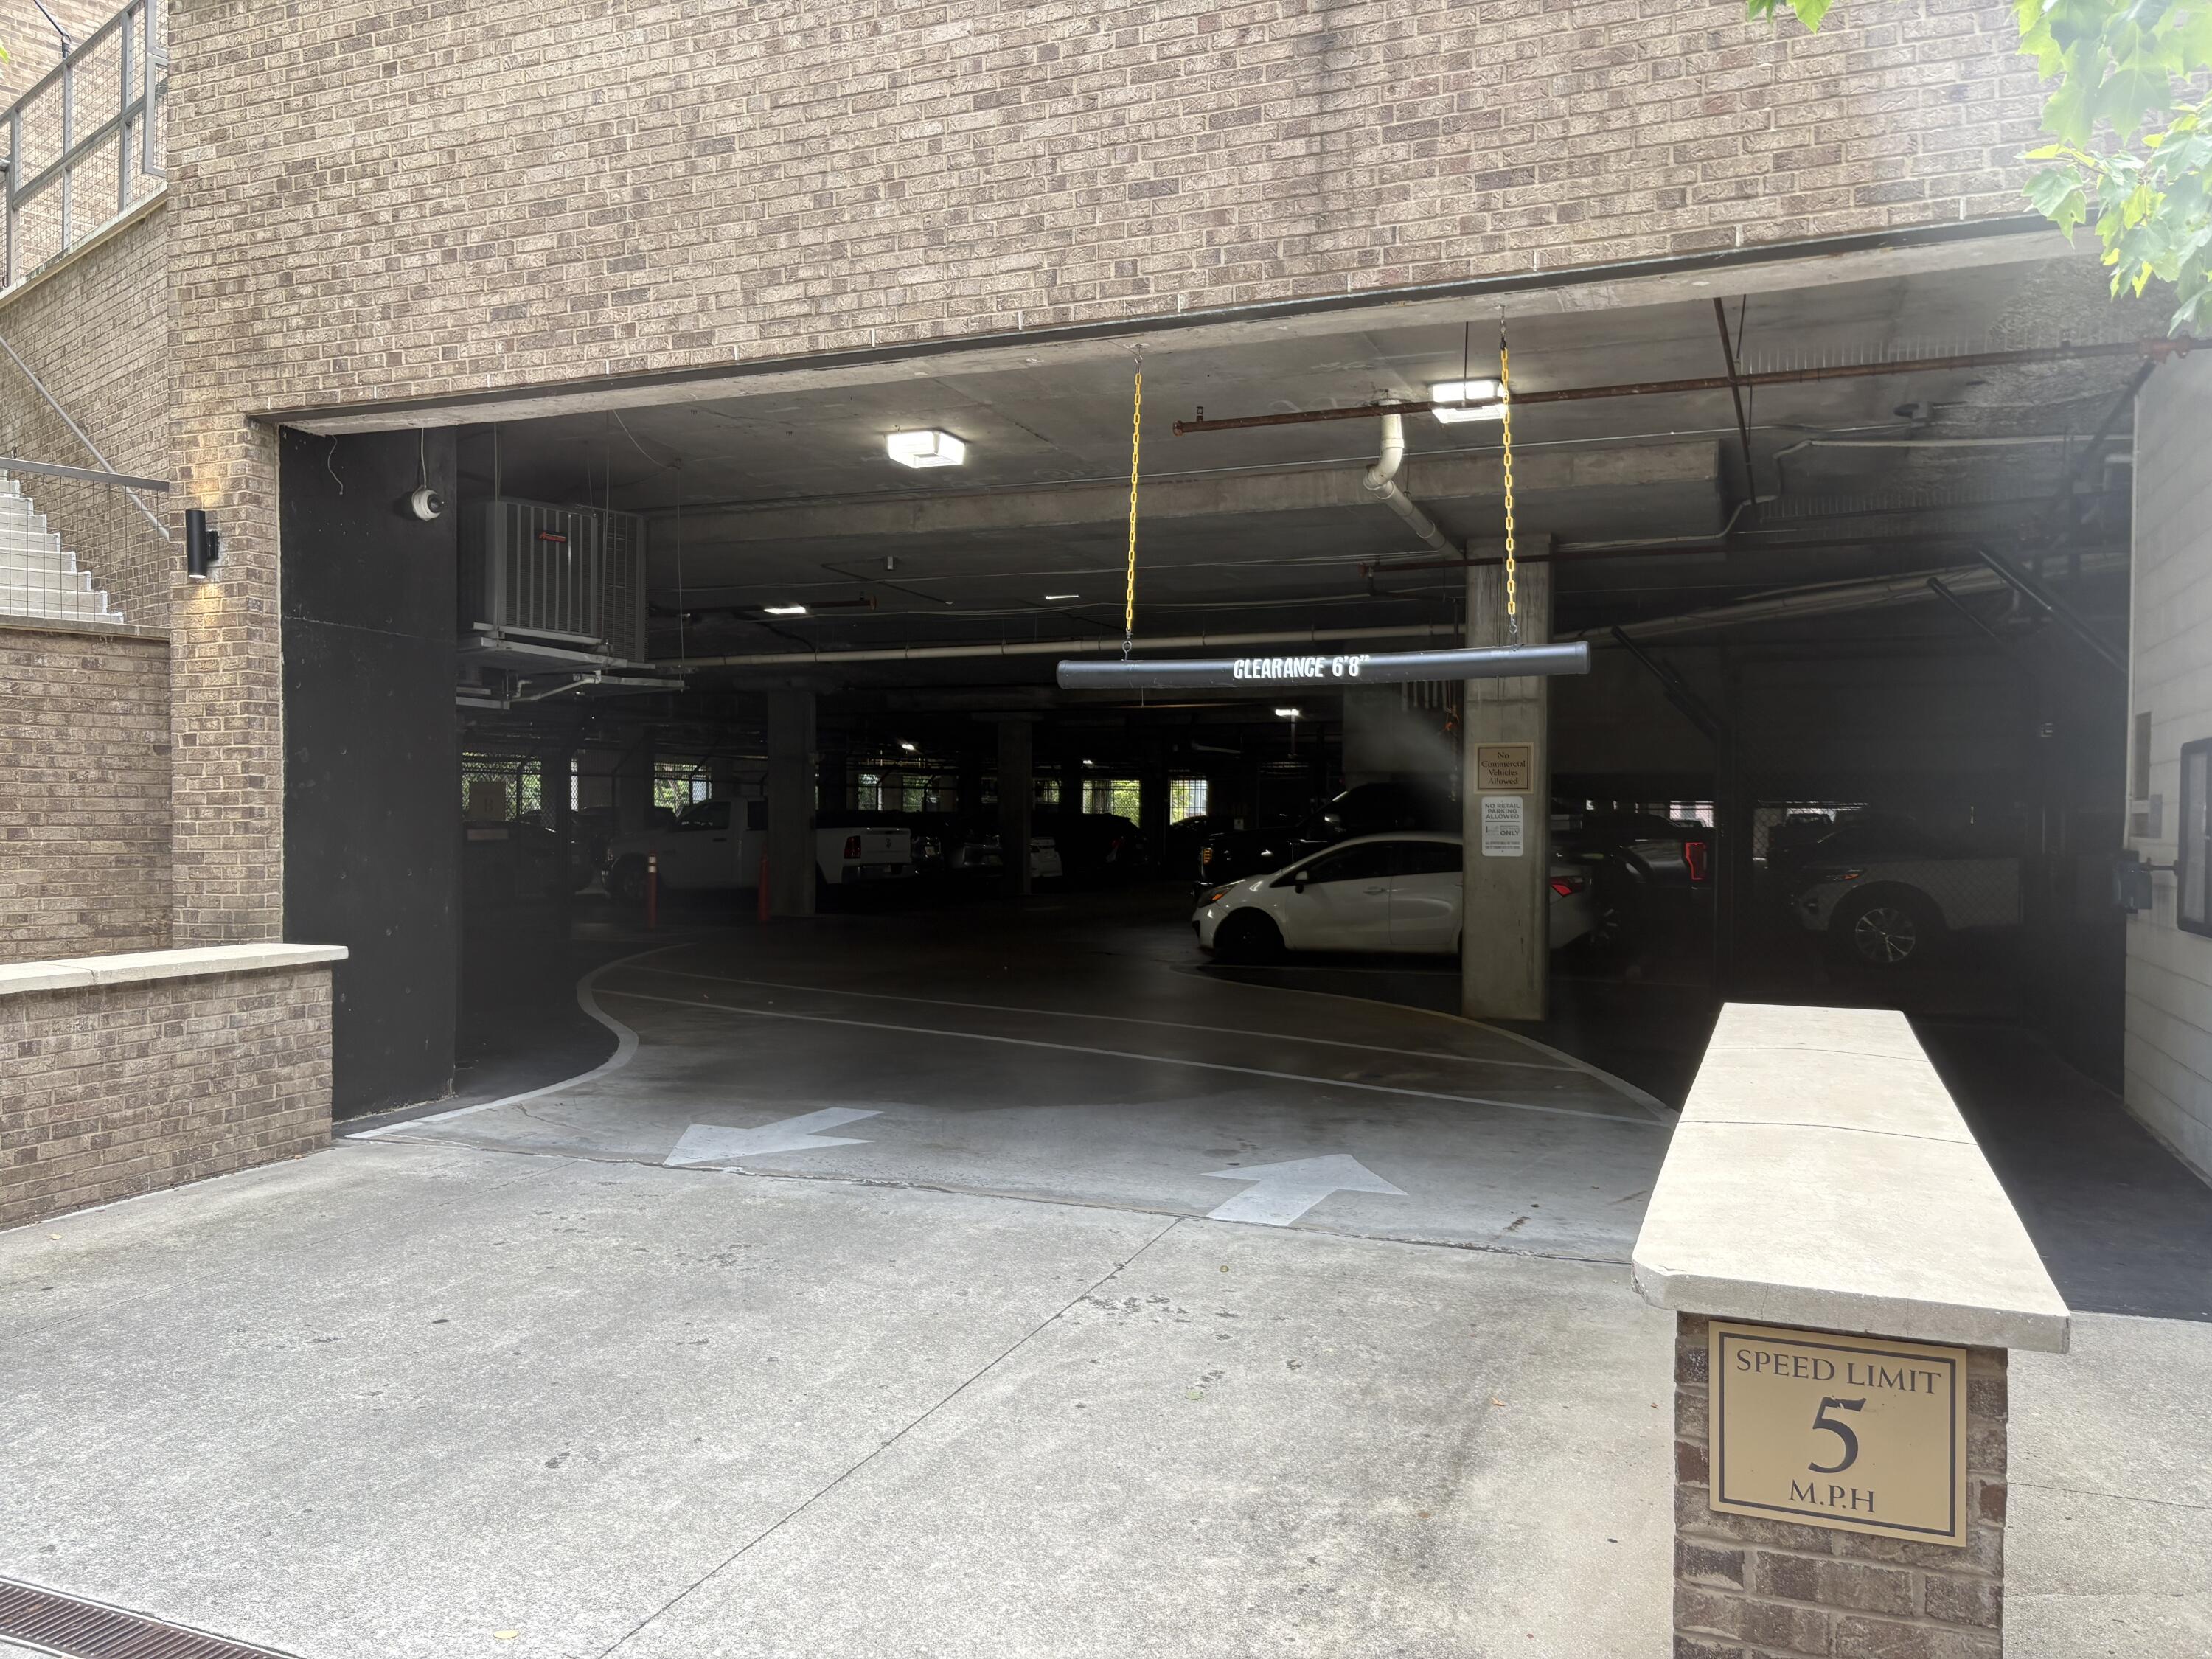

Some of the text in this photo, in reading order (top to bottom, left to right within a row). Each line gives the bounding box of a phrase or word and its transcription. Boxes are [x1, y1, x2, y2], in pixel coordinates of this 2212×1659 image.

[1233, 657, 1326, 680] CLEARANCE
[1481, 760, 1526, 768] Commercial
[1488, 768, 1518, 776] Vehicles
[1736, 1349, 1941, 1394] SPEED LIMIT
[1808, 1395, 1867, 1474] 5
[1788, 1478, 1875, 1513] M.P.H
